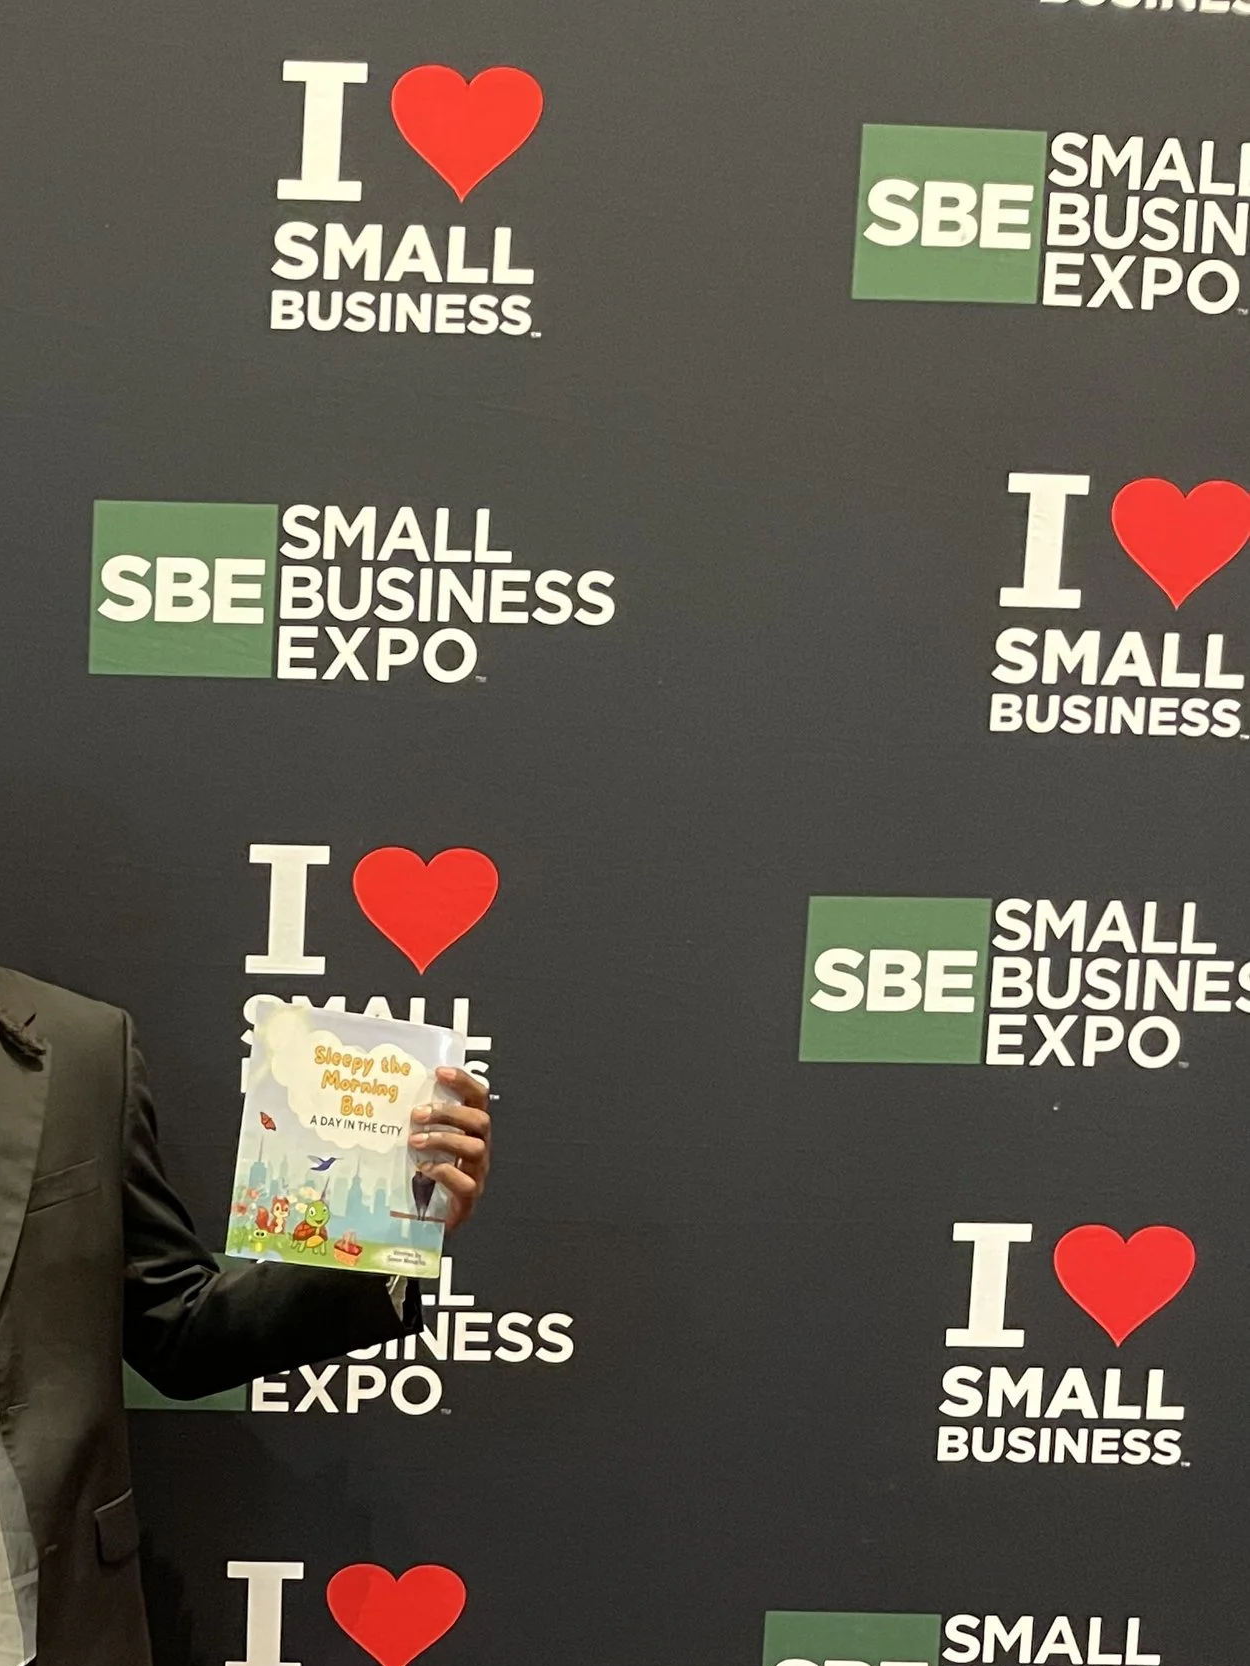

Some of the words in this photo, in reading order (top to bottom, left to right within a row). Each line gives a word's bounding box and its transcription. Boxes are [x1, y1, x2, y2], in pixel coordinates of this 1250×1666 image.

[277, 60, 368, 201] I
[863, 178, 1034, 250] SBE
[1047, 192, 1250, 256] BUSIN
[271, 221, 534, 284] SMALL
[271, 290, 532, 335] BUSINESS
[1043, 252, 1239, 314] EXPO
[280, 504, 512, 563] SMALL
[999, 473, 1090, 609] I
[97, 555, 266, 624] SBE
[280, 565, 615, 625] BUSINESS
[277, 626, 477, 683] EXPO
[992, 628, 1244, 689] SMALL
[990, 694, 1241, 737] BUSINESS
[245, 844, 330, 975] I
[992, 898, 1217, 954] SMALL
[810, 948, 979, 1013] SBE
[989, 955, 1250, 1014] BUSINE
[314, 1045, 375, 1076] Sleepy
[381, 1055, 412, 1076] the
[986, 1014, 1180, 1068] EXPO
[321, 1070, 399, 1103] Morning
[340, 1096, 374, 1118] Bat
[310, 1115, 317, 1125] A
[320, 1116, 342, 1129] DAY
[344, 1119, 355, 1130] IN
[358, 1120, 378, 1133] THE
[380, 1123, 403, 1136] CITY
[946, 1223, 1032, 1347] I
[252, 1365, 442, 1415] EXPO
[939, 1366, 1184, 1420] SMALL
[937, 1426, 1181, 1465] BUSINESS
[942, 1615, 1160, 1666] SMALL
